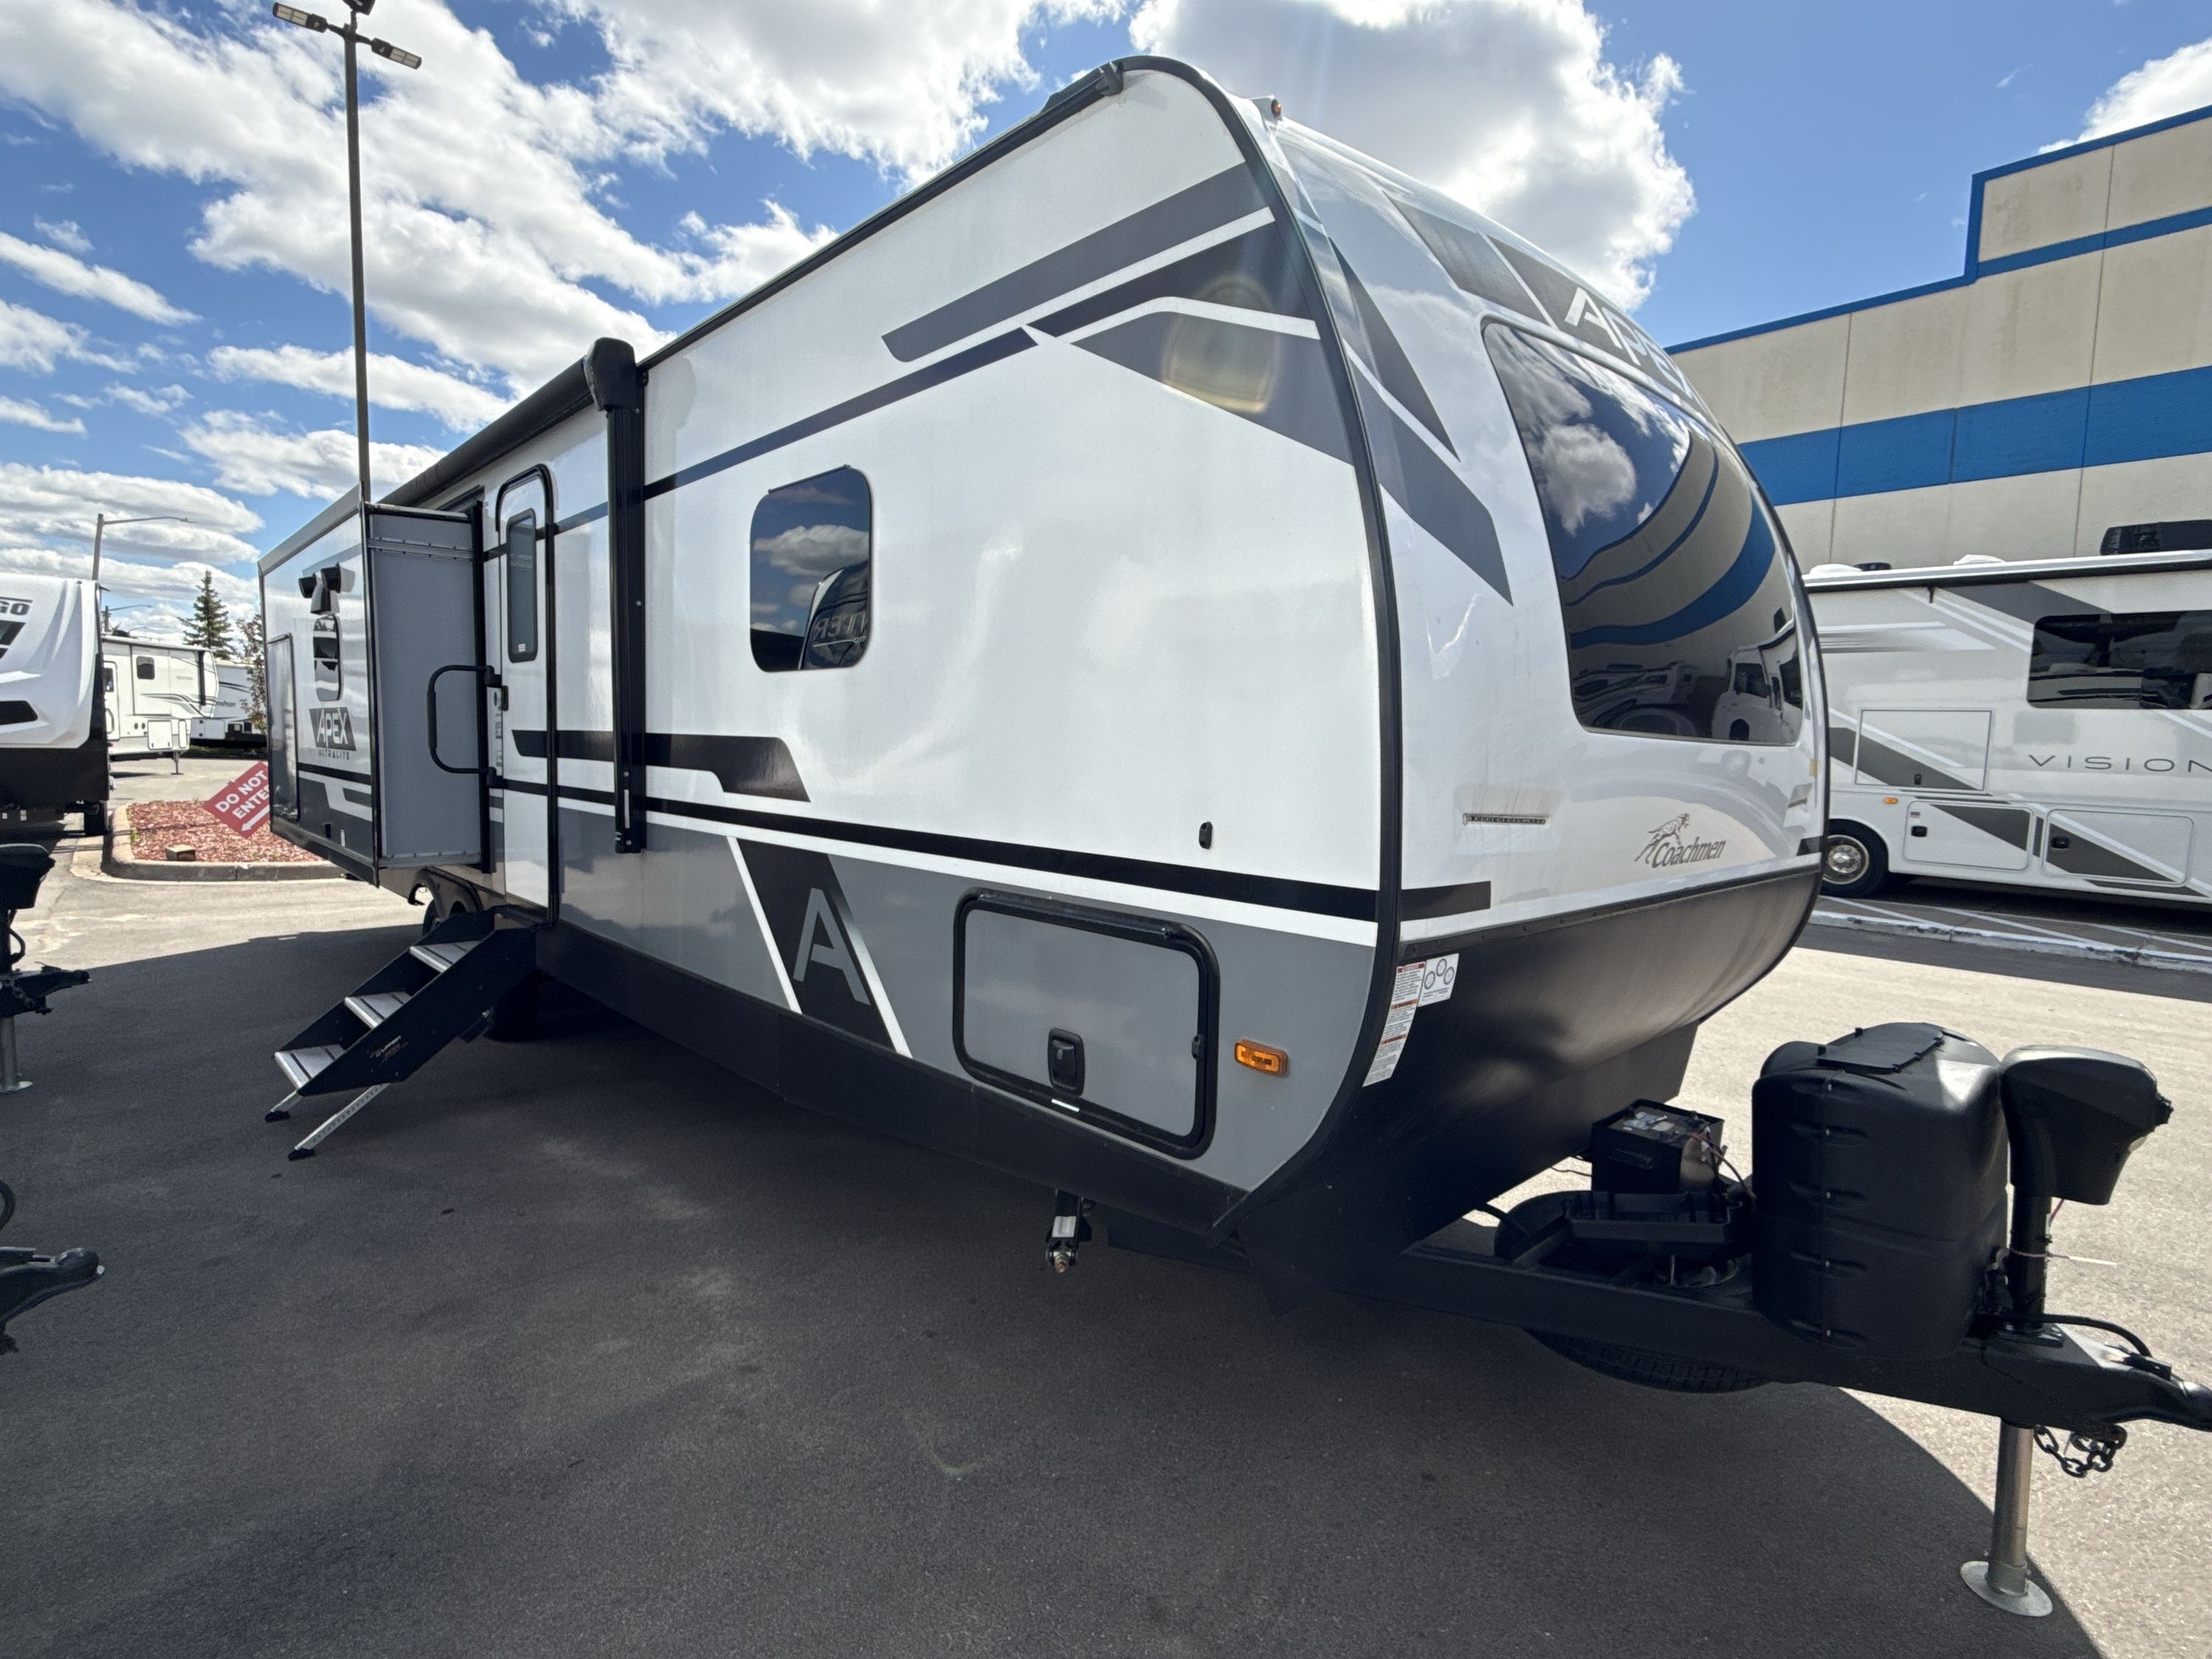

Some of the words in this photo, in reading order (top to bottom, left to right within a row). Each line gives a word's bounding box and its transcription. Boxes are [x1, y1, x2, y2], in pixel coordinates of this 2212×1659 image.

[317, 709, 349, 748] APEX
[215, 793, 240, 813] DO
[237, 770, 268, 795] NOT
[1652, 836, 1726, 869] Coachmen
[793, 887, 872, 1006] A
